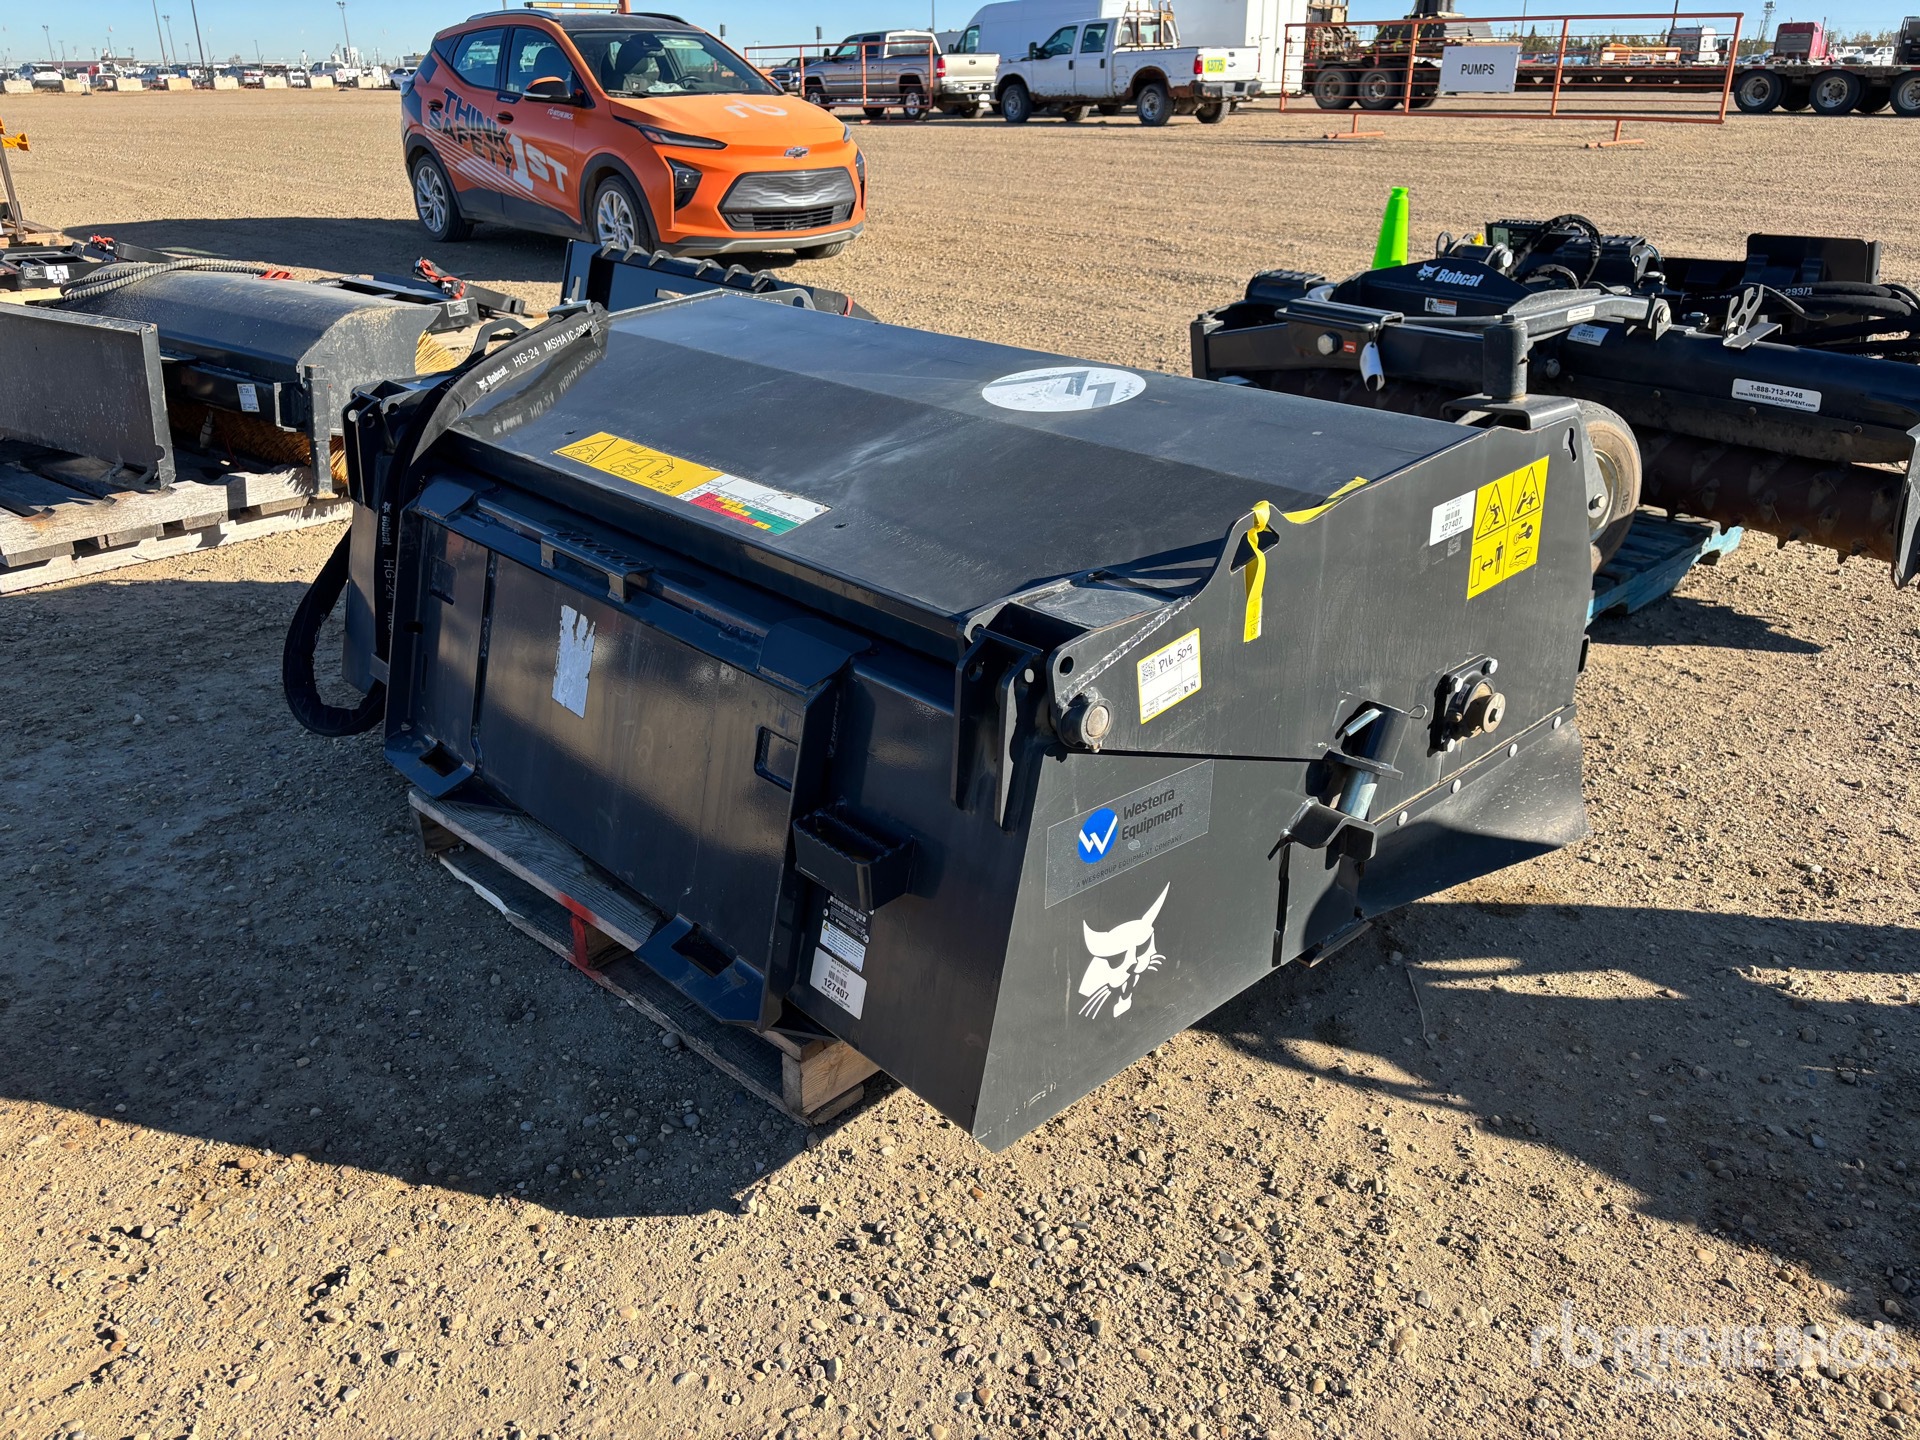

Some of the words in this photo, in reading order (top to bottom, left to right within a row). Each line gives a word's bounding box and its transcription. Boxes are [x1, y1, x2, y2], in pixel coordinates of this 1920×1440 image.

[1460, 63, 1495, 75] PUMPS
[443, 88, 508, 150] THINK
[429, 110, 513, 176] SAFETY
[508, 133, 568, 193] 1ST
[1435, 268, 1484, 287] Bobcat
[512, 346, 540, 367] HG-24
[543, 334, 567, 351] MSHA
[1750, 384, 1803, 399] 1-888-713-4748
[1441, 516, 1463, 533] 127407
[1176, 643, 1193, 662] 509
[1123, 788, 1175, 820] Westerra
[1121, 803, 1184, 841] Equipment
[1081, 864, 1117, 887] WESGROUP
[1118, 847, 1153, 869] EQUIPMENT
[1153, 833, 1184, 852] COMPANY
[823, 977, 850, 1001] 127407
